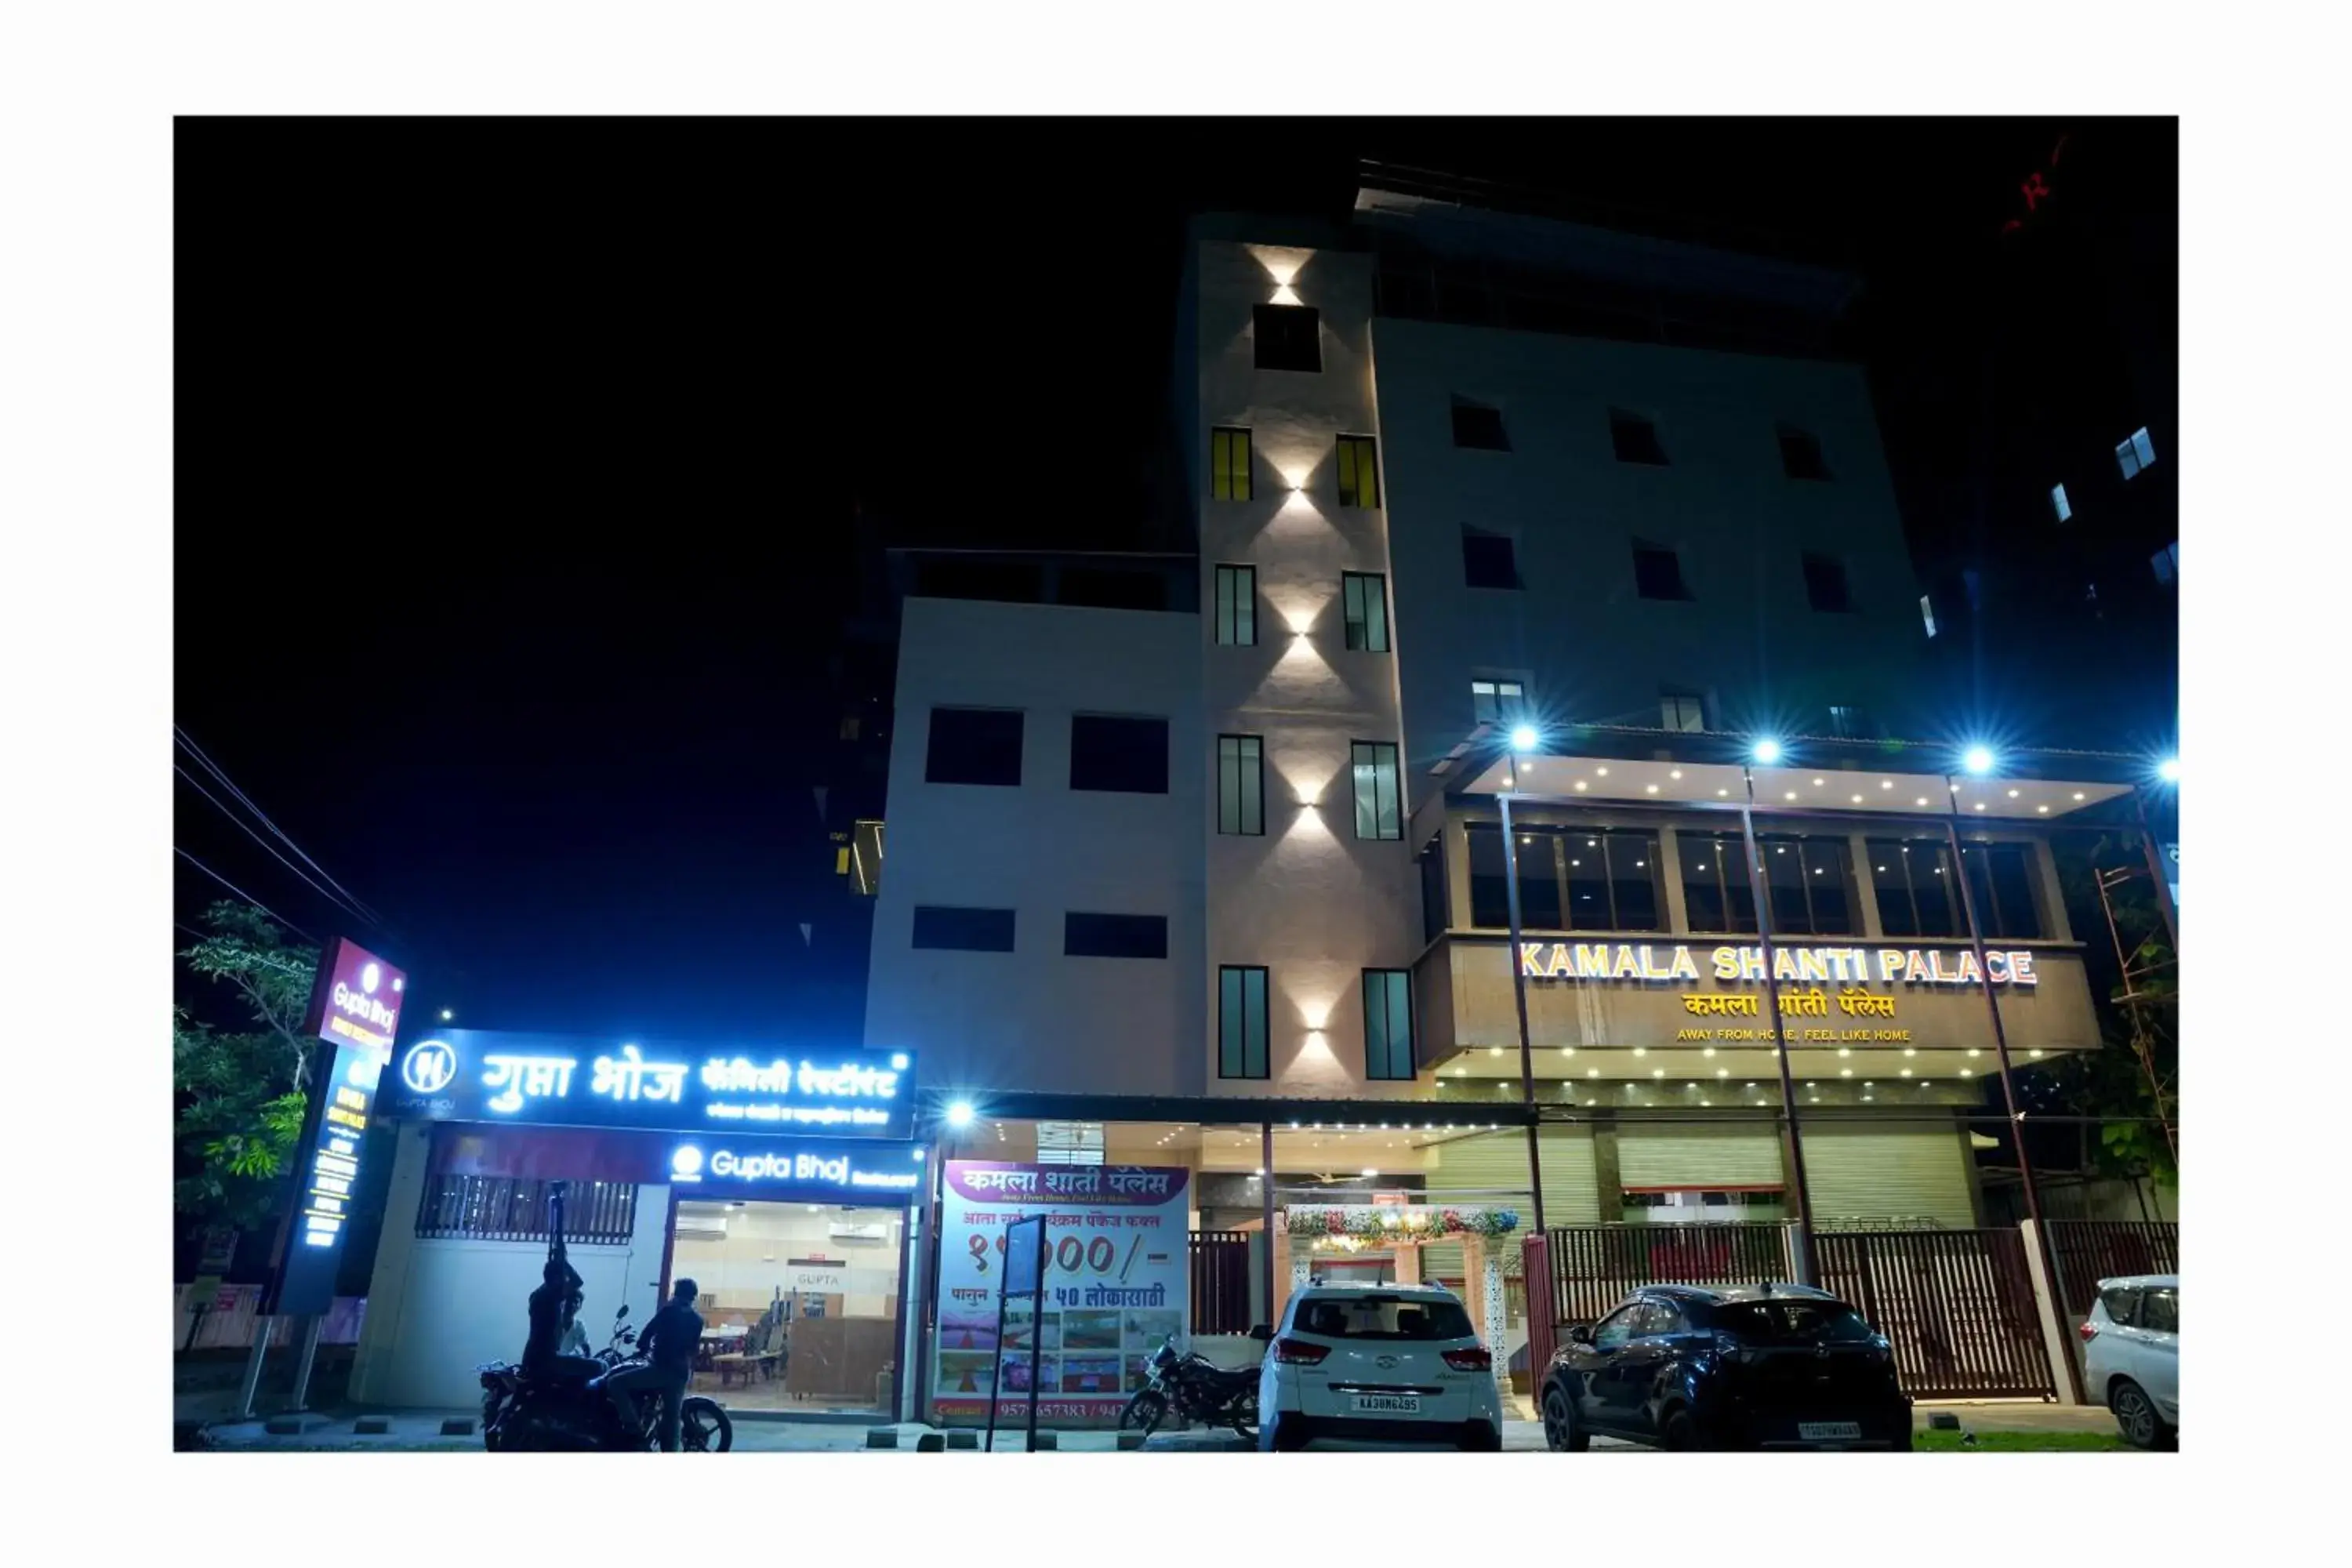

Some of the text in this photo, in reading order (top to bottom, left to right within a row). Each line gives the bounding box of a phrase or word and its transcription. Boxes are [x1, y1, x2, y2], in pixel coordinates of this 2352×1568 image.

[1521, 943, 2037, 983] KAMALA SHANTI PALACE
[1682, 994, 1758, 1017] कमला
[1837, 985, 1895, 1017] पॅलेस
[1677, 1029, 1911, 1042] AWAY FROM HOE, FEEL LIKE HOME
[591, 1044, 689, 1103] भोज
[711, 1150, 791, 1182] Gupta
[796, 1155, 848, 1185] Bhoj
[962, 1169, 1038, 1192] कमला
[797, 1273, 839, 1287] GUPTA
